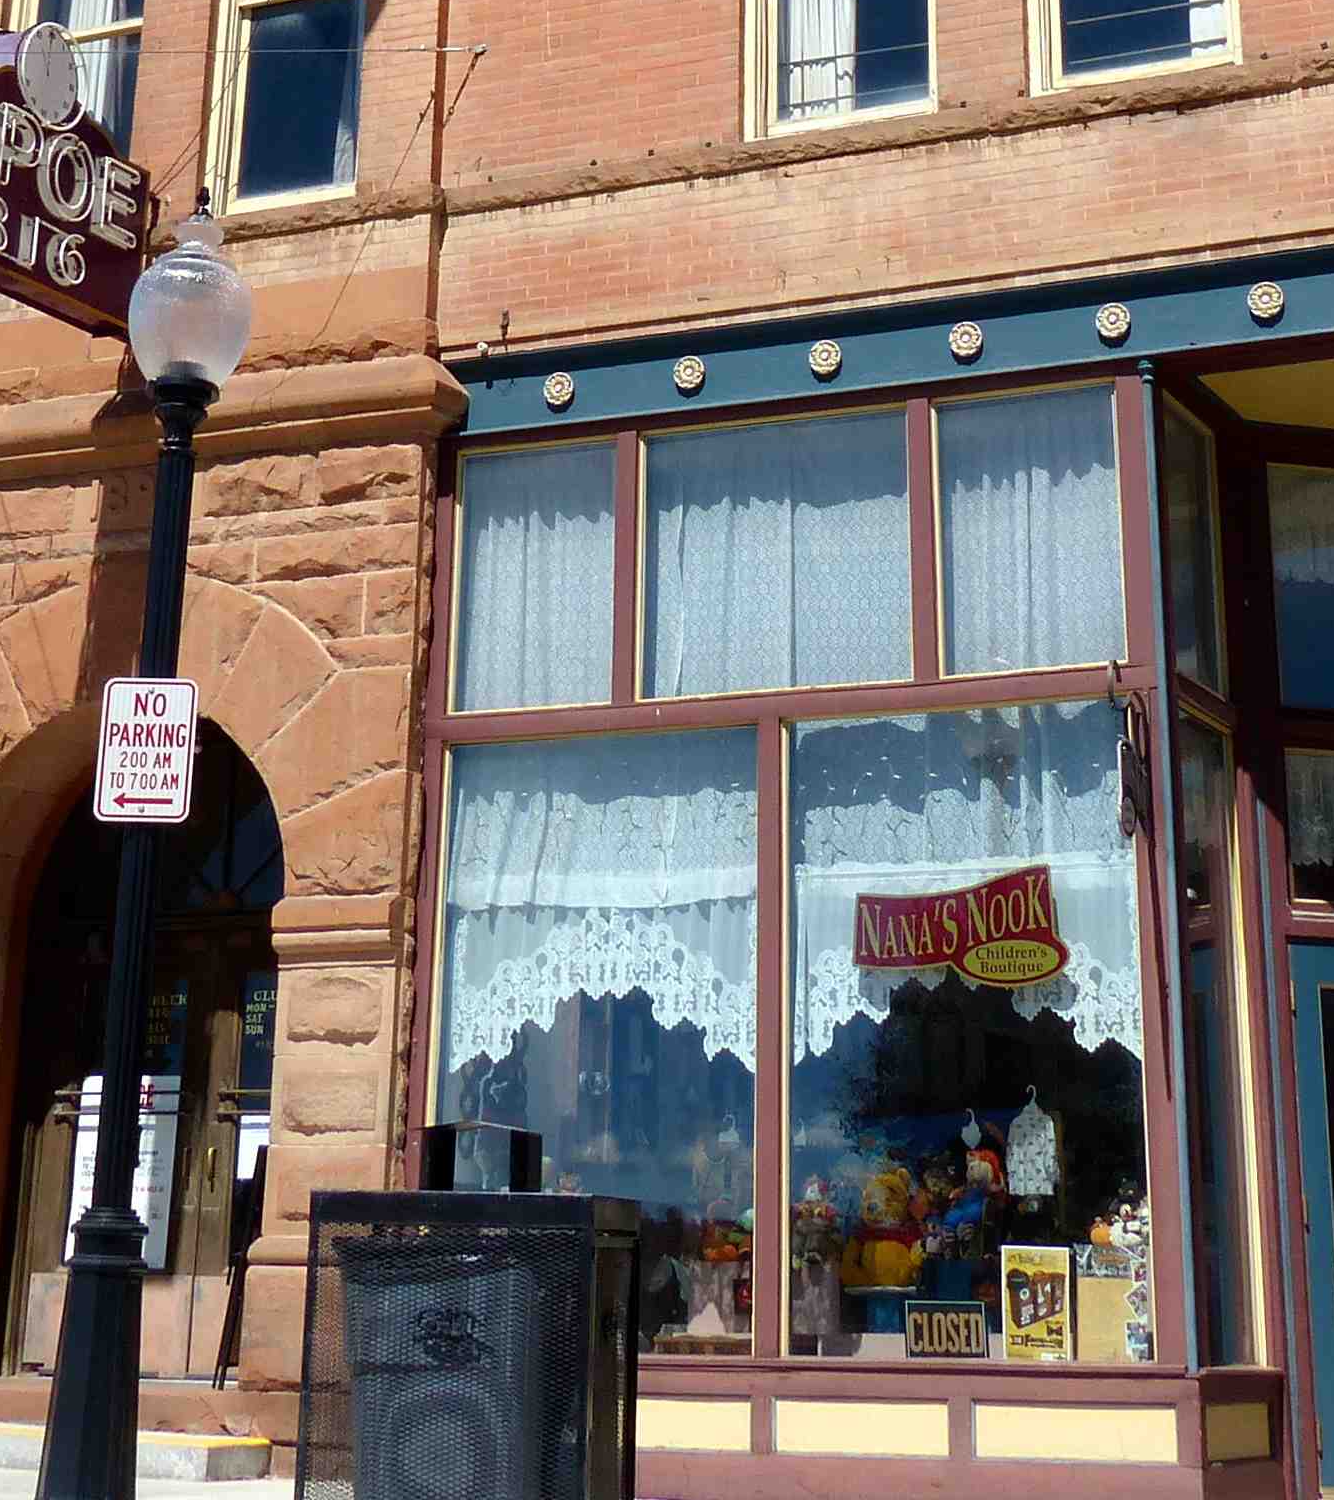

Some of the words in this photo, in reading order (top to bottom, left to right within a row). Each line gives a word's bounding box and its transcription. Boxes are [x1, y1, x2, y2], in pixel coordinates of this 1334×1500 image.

[133, 692, 167, 717] NO
[108, 722, 188, 748] PARKING
[153, 752, 172, 769] AM
[110, 771, 125, 789] TO
[160, 773, 180, 790] AM
[859, 898, 959, 959] NANA'S
[966, 873, 1049, 946] NOOK
[975, 944, 1048, 961] Children's
[979, 959, 1044, 976] Boutique
[908, 1311, 984, 1353] CLOSED
